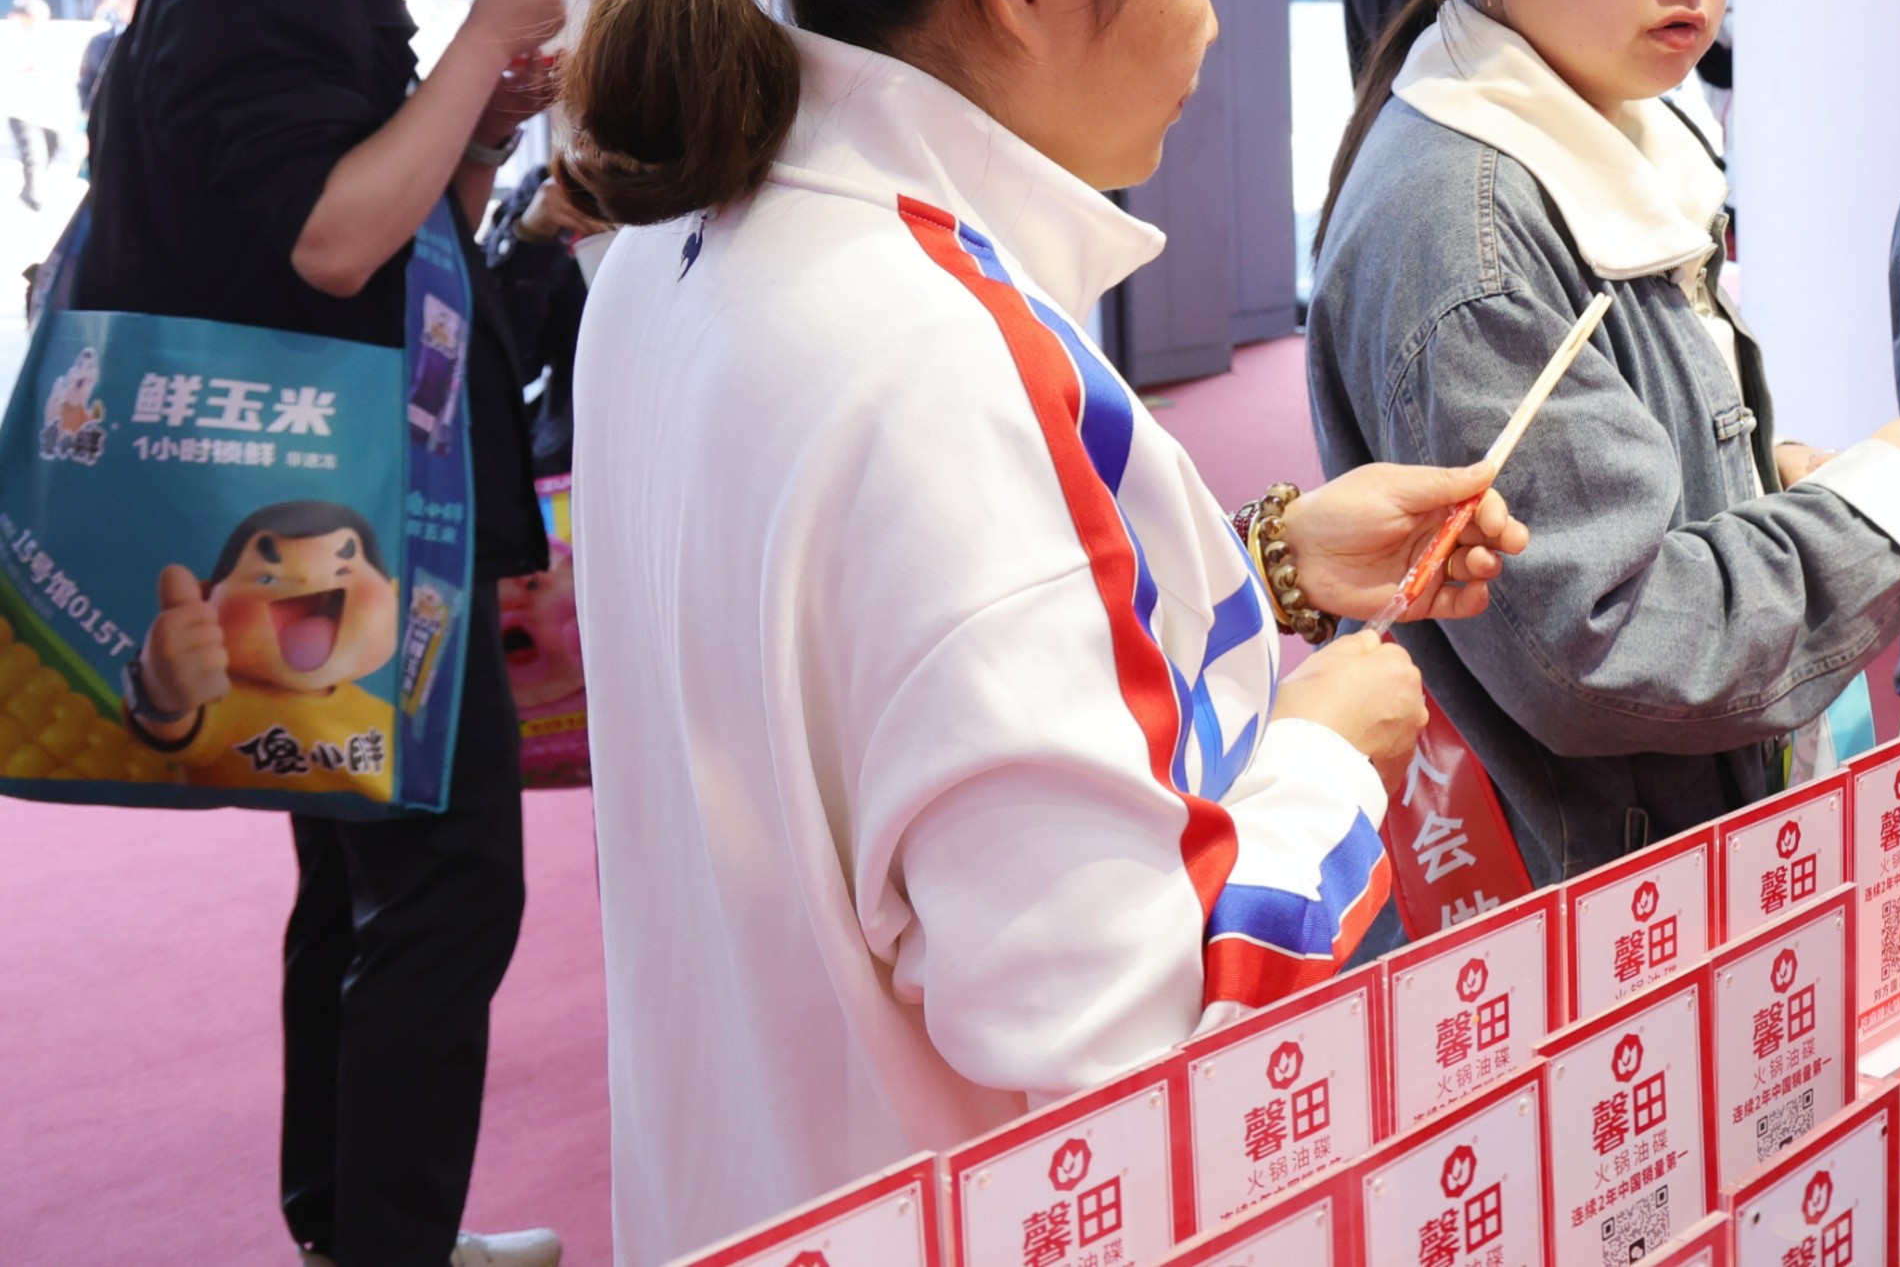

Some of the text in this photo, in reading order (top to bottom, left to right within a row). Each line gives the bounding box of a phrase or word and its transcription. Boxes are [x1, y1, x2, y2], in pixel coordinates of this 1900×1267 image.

[131, 373, 336, 436] 鲜玉米
[133, 437, 276, 467] 1小时锁鲜
[1760, 853, 1817, 915] 馨田
[1614, 914, 1678, 984] 馨田
[1436, 992, 1510, 1070] 馨田
[1752, 983, 1816, 1060] 馨田
[1436, 1046, 1511, 1100] 火锅油碟
[1732, 1057, 1832, 1125] 连续2年中国销量第一
[1752, 1037, 1816, 1091] 火锅油碟
[1244, 1077, 1330, 1163] 馨田
[1592, 1070, 1667, 1156] 馨田
[1246, 1135, 1332, 1196] 火锅油碟
[1571, 1149, 1689, 1229] 连续2年中国销量第一
[1594, 1129, 1668, 1191] 火锅油碟
[1022, 1175, 1123, 1267] 馨田
[1418, 1180, 1503, 1267] 馨田
